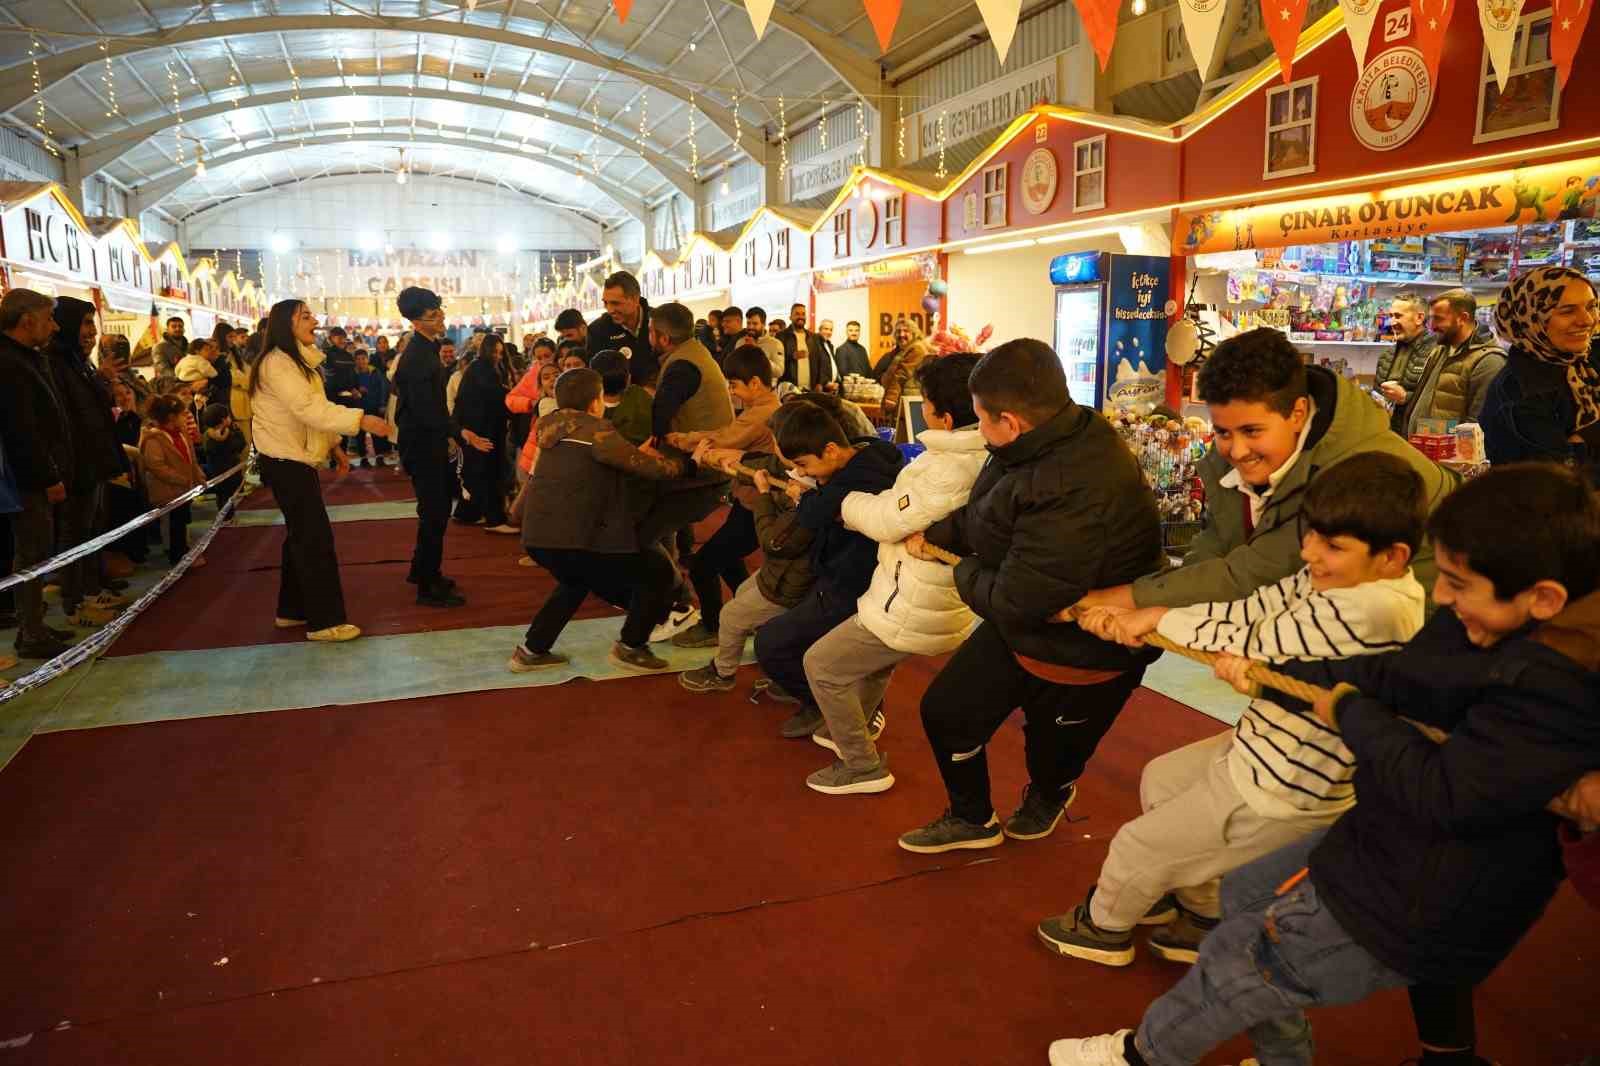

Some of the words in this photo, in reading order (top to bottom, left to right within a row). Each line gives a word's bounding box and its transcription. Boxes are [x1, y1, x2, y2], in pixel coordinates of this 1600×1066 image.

[1386, 13, 1409, 36] 24
[1358, 65, 1381, 105] KAHTA
[1279, 206, 1353, 237] ÇINAR
[1358, 185, 1503, 223] OYUNCAK
[348, 249, 478, 267] RAMAZAN
[1136, 290, 1152, 307] iyi
